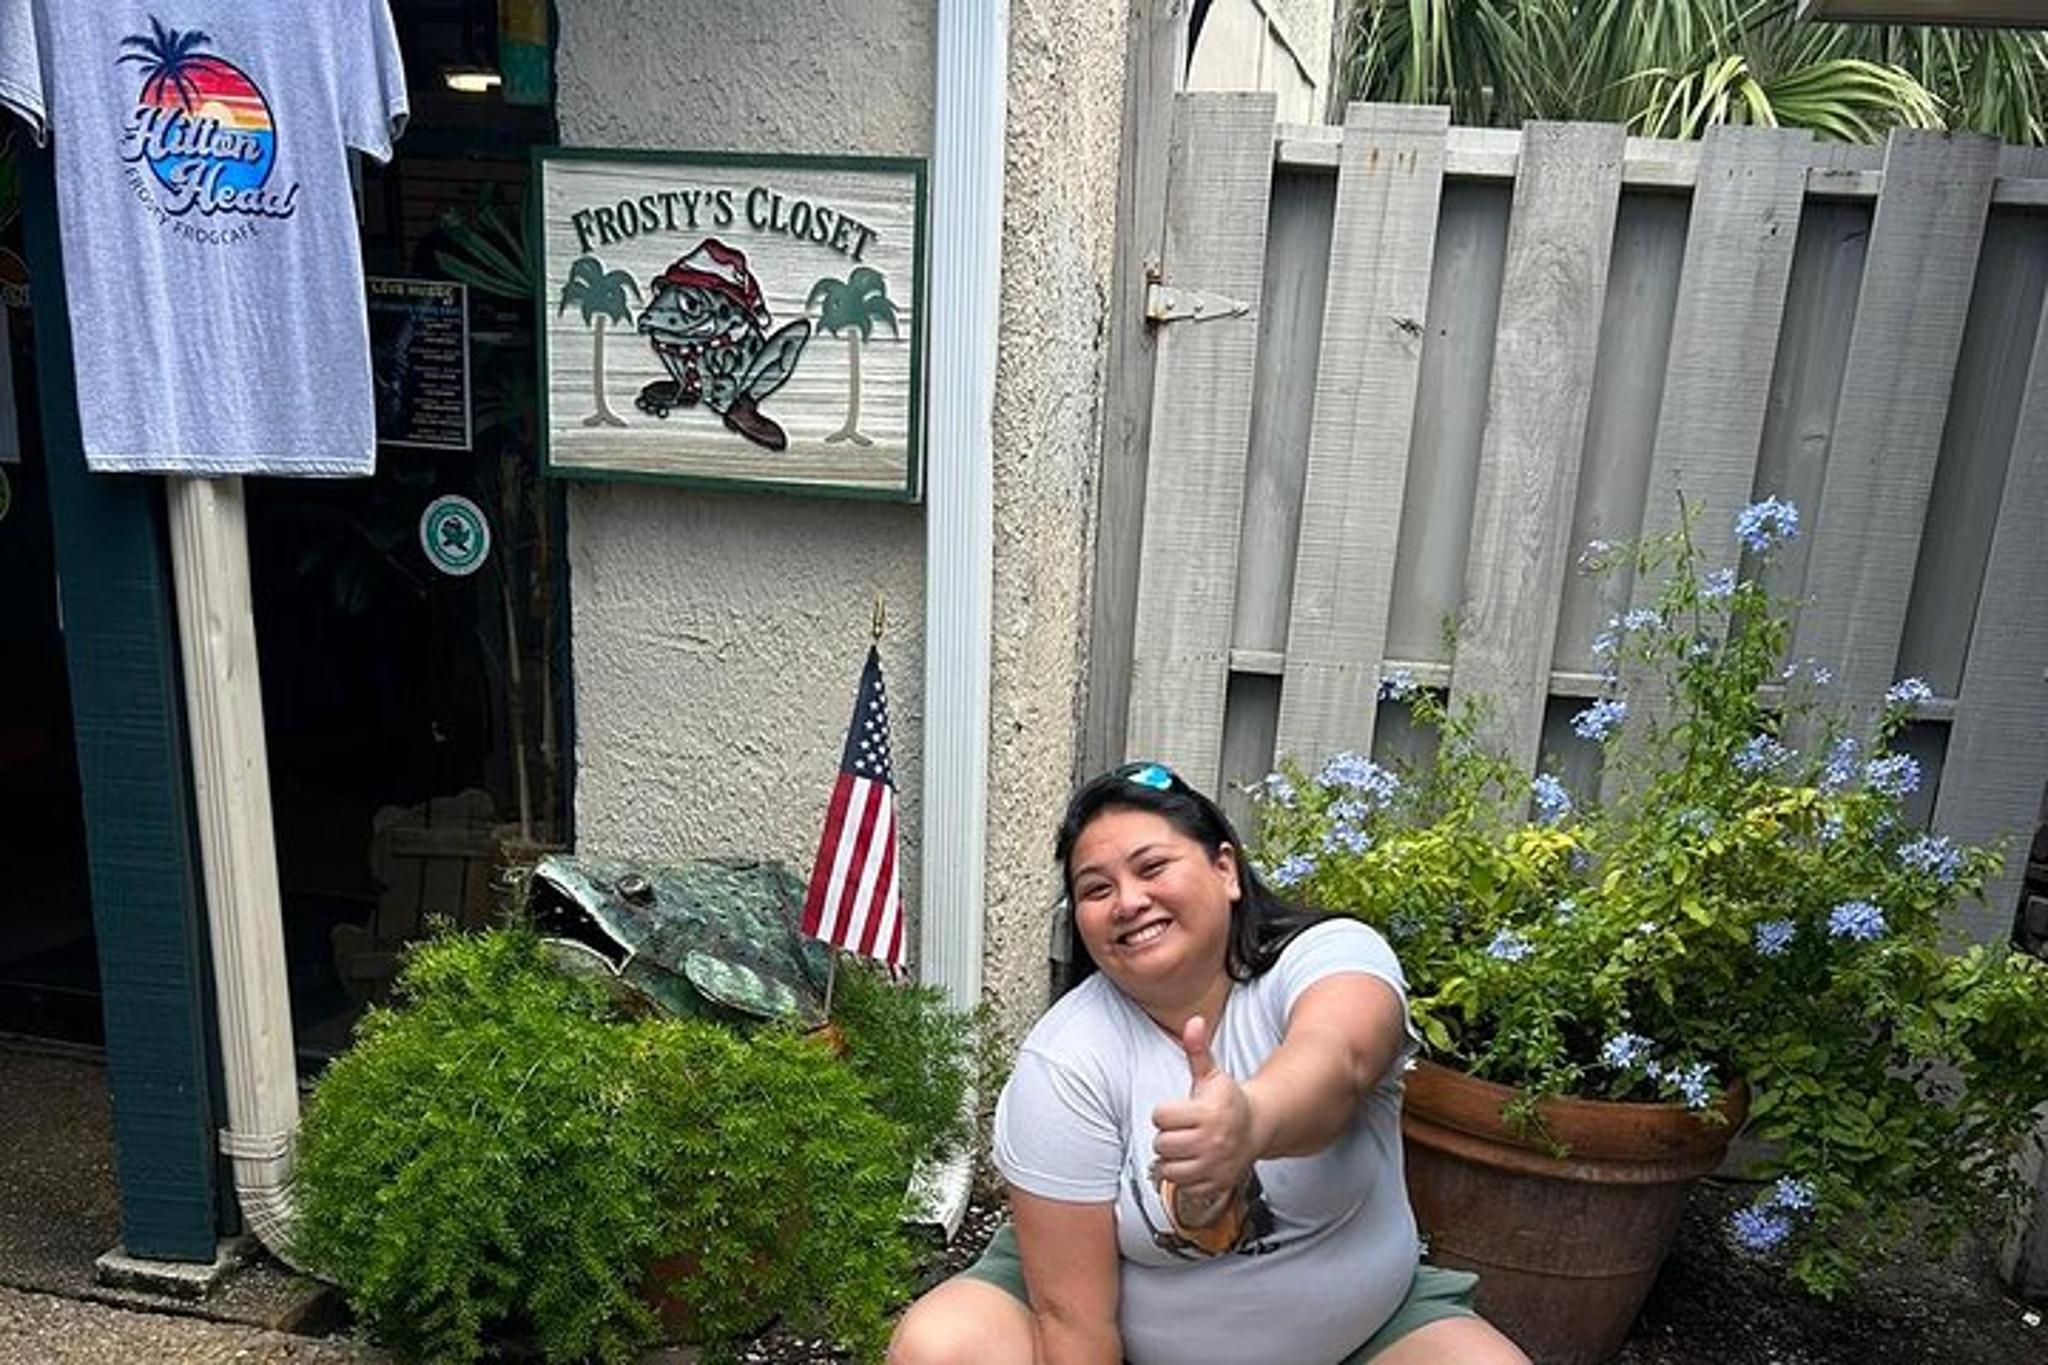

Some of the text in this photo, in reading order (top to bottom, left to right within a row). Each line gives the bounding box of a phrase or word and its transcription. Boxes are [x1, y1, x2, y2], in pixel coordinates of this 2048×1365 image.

[119, 106, 263, 163] Hilton
[164, 161, 300, 219] Head
[572, 186, 878, 263] FROSTY'S CLOSET
